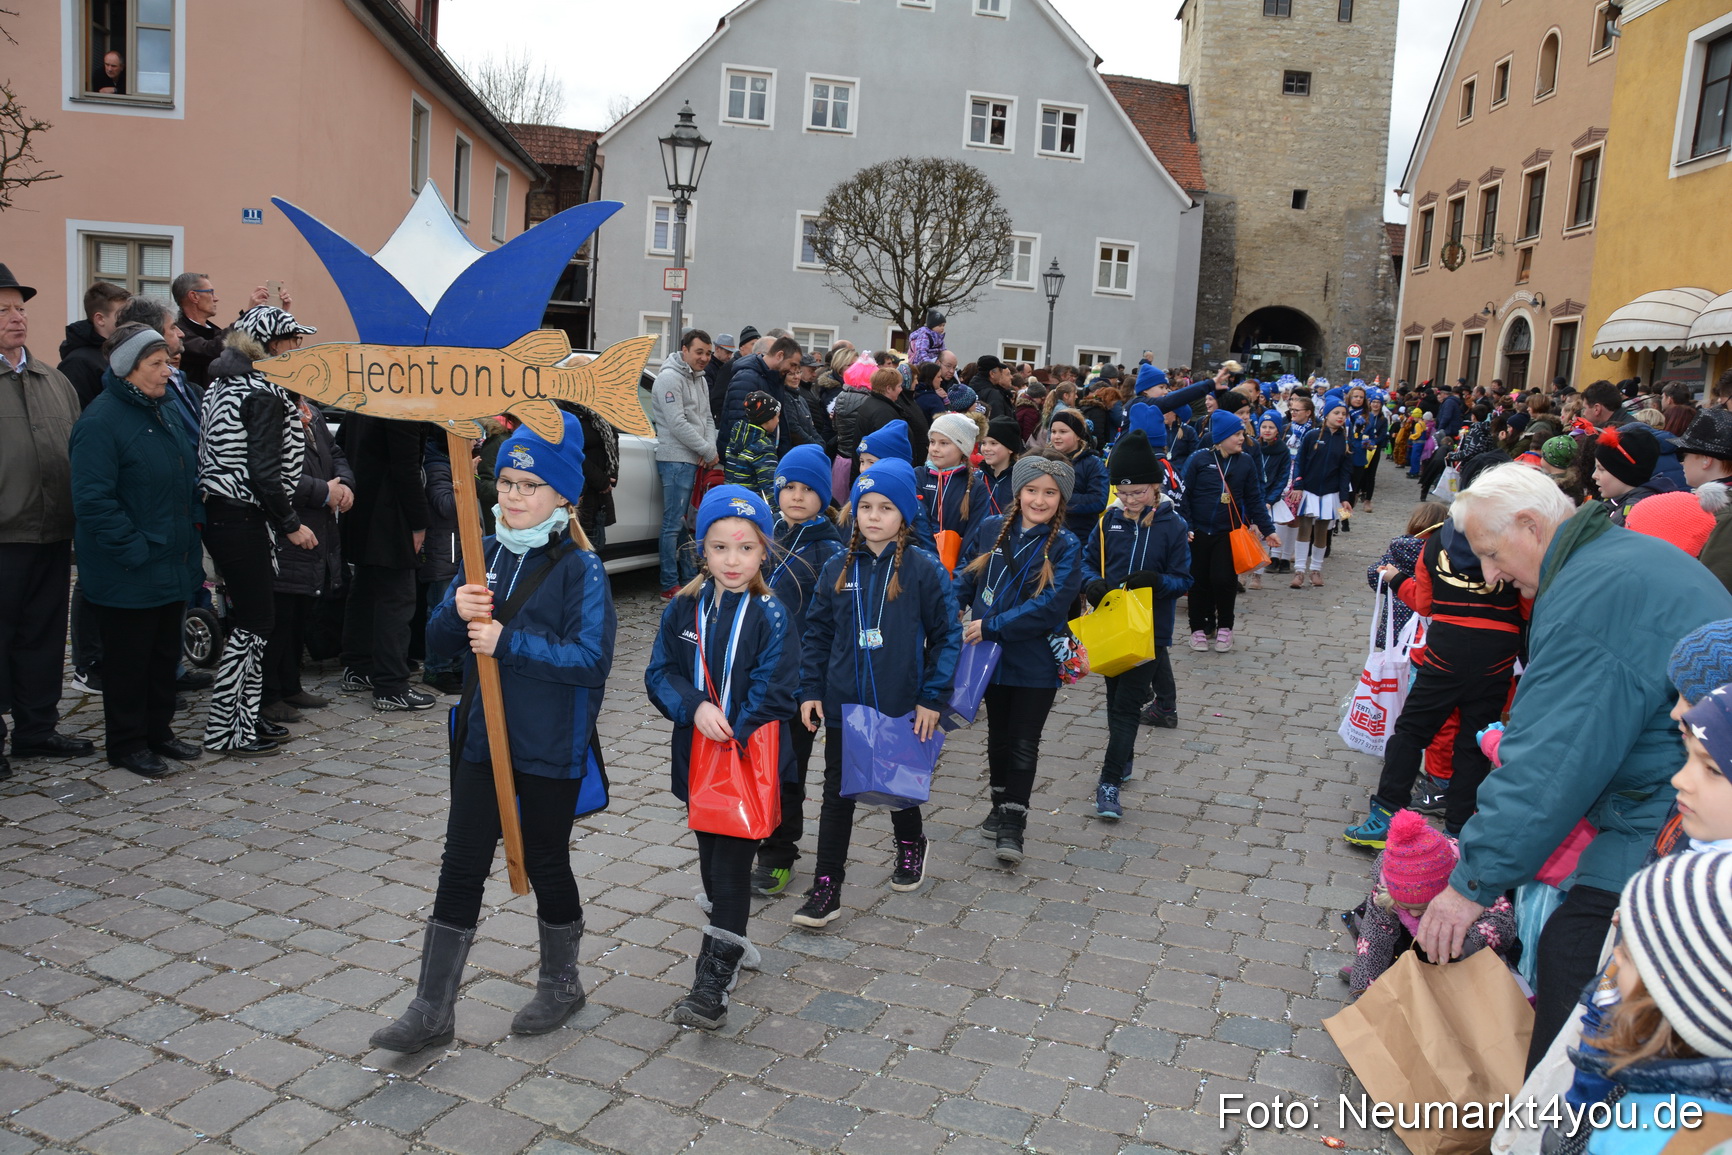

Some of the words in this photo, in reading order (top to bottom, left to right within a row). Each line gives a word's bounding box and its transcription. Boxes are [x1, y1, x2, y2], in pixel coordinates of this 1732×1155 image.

[248, 209, 258, 218] 11
[345, 352, 548, 399] Hechtonia
[682, 629, 698, 641] JAKO
